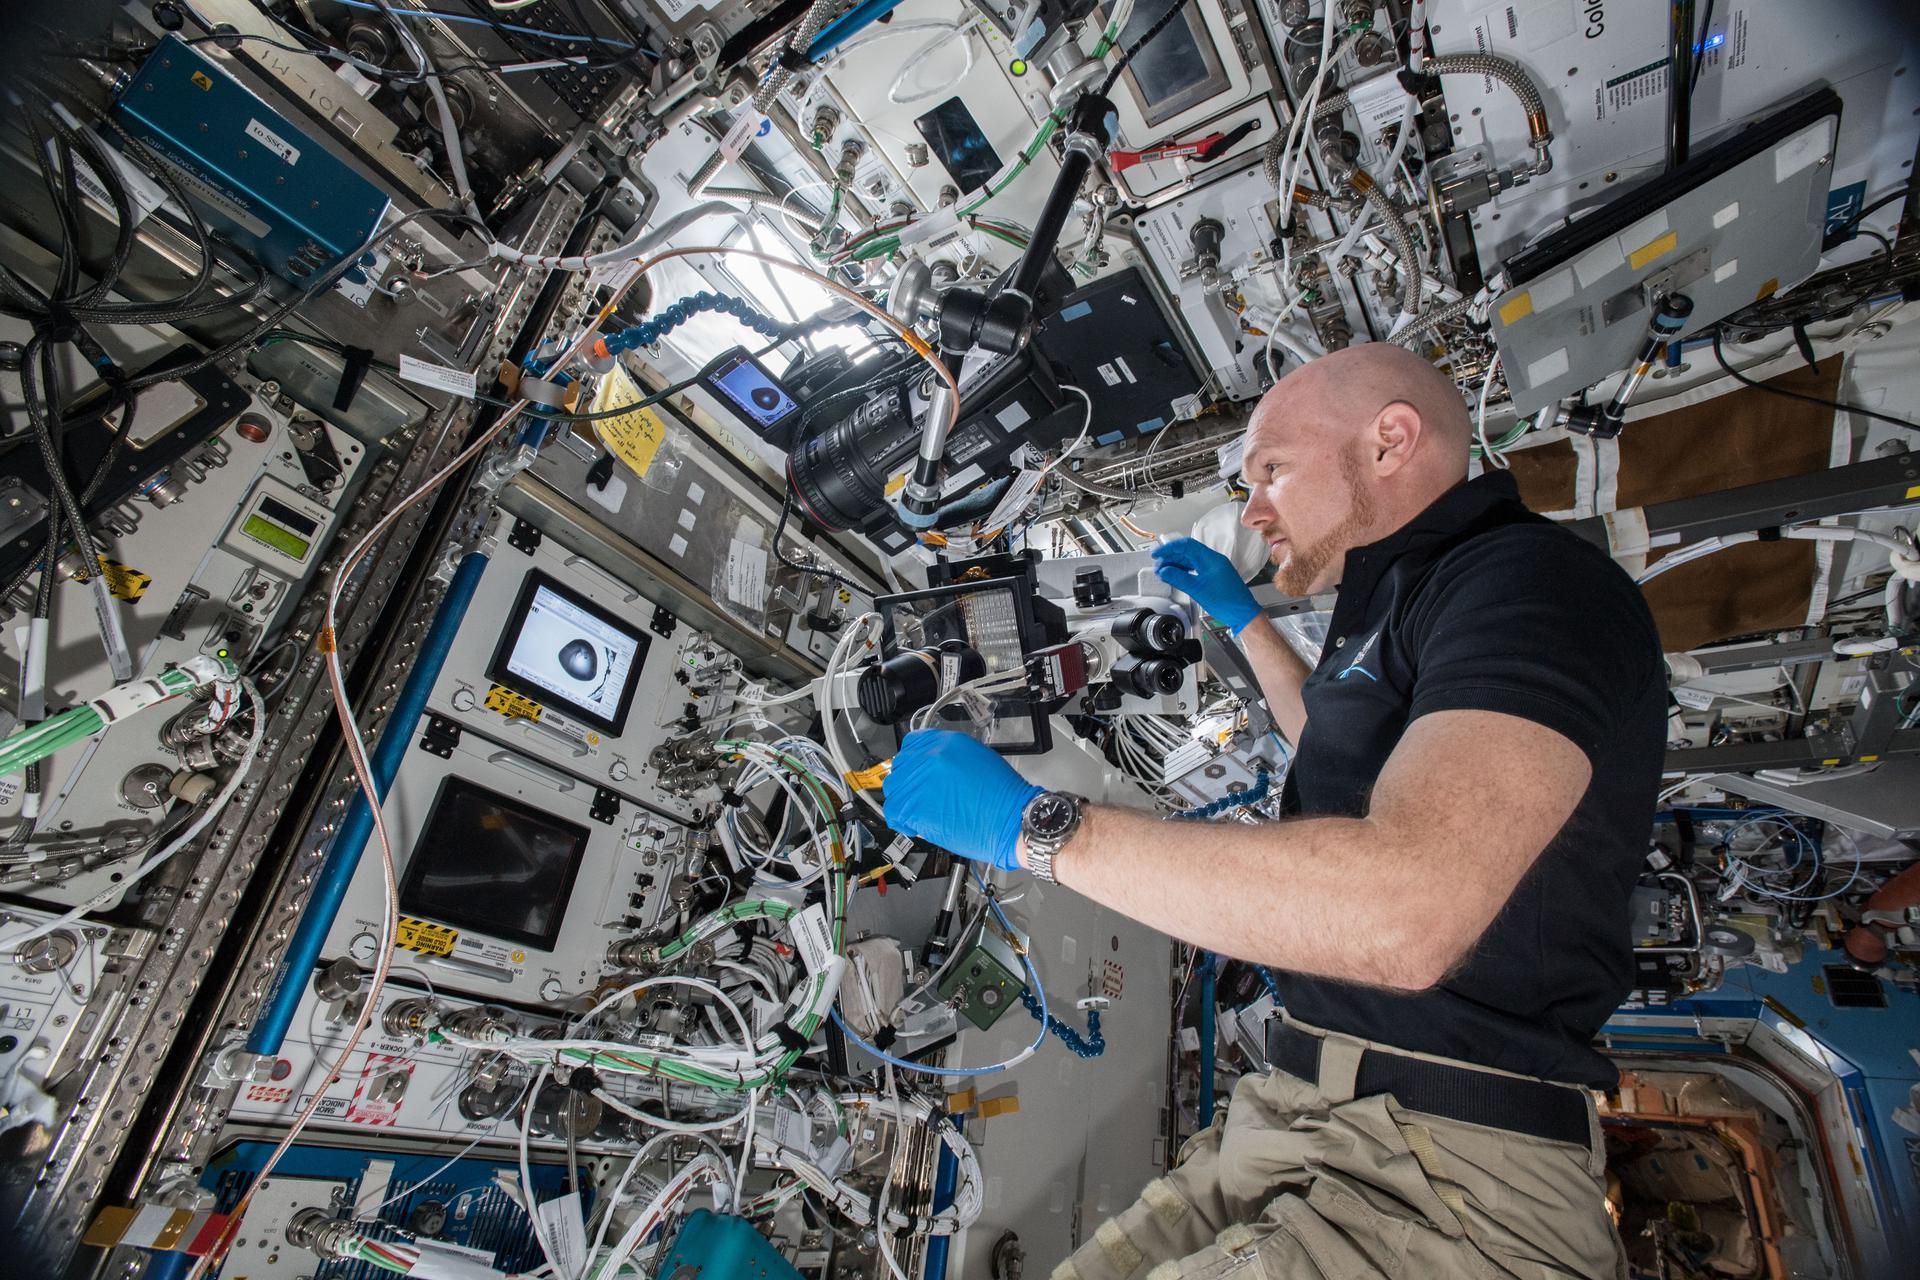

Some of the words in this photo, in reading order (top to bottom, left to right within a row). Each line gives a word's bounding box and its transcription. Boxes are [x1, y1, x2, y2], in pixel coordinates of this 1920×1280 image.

[251, 126, 264, 139] to
[262, 136, 282, 153] SSC
[198, 172, 229, 195] Power
[226, 190, 252, 212] Supply
[1151, 219, 1168, 245] Electronics
[1164, 245, 1175, 260] Power
[417, 934, 433, 943] INSIDE
[433, 938, 447, 946] COLD
[415, 940, 444, 952] WARNING
[22, 976, 41, 984] DATA
[15, 1006, 31, 1018] L1
[379, 1042, 406, 1053] LOCKER
[304, 1097, 345, 1107] INDICATN
[313, 1106, 335, 1114] SMOK
